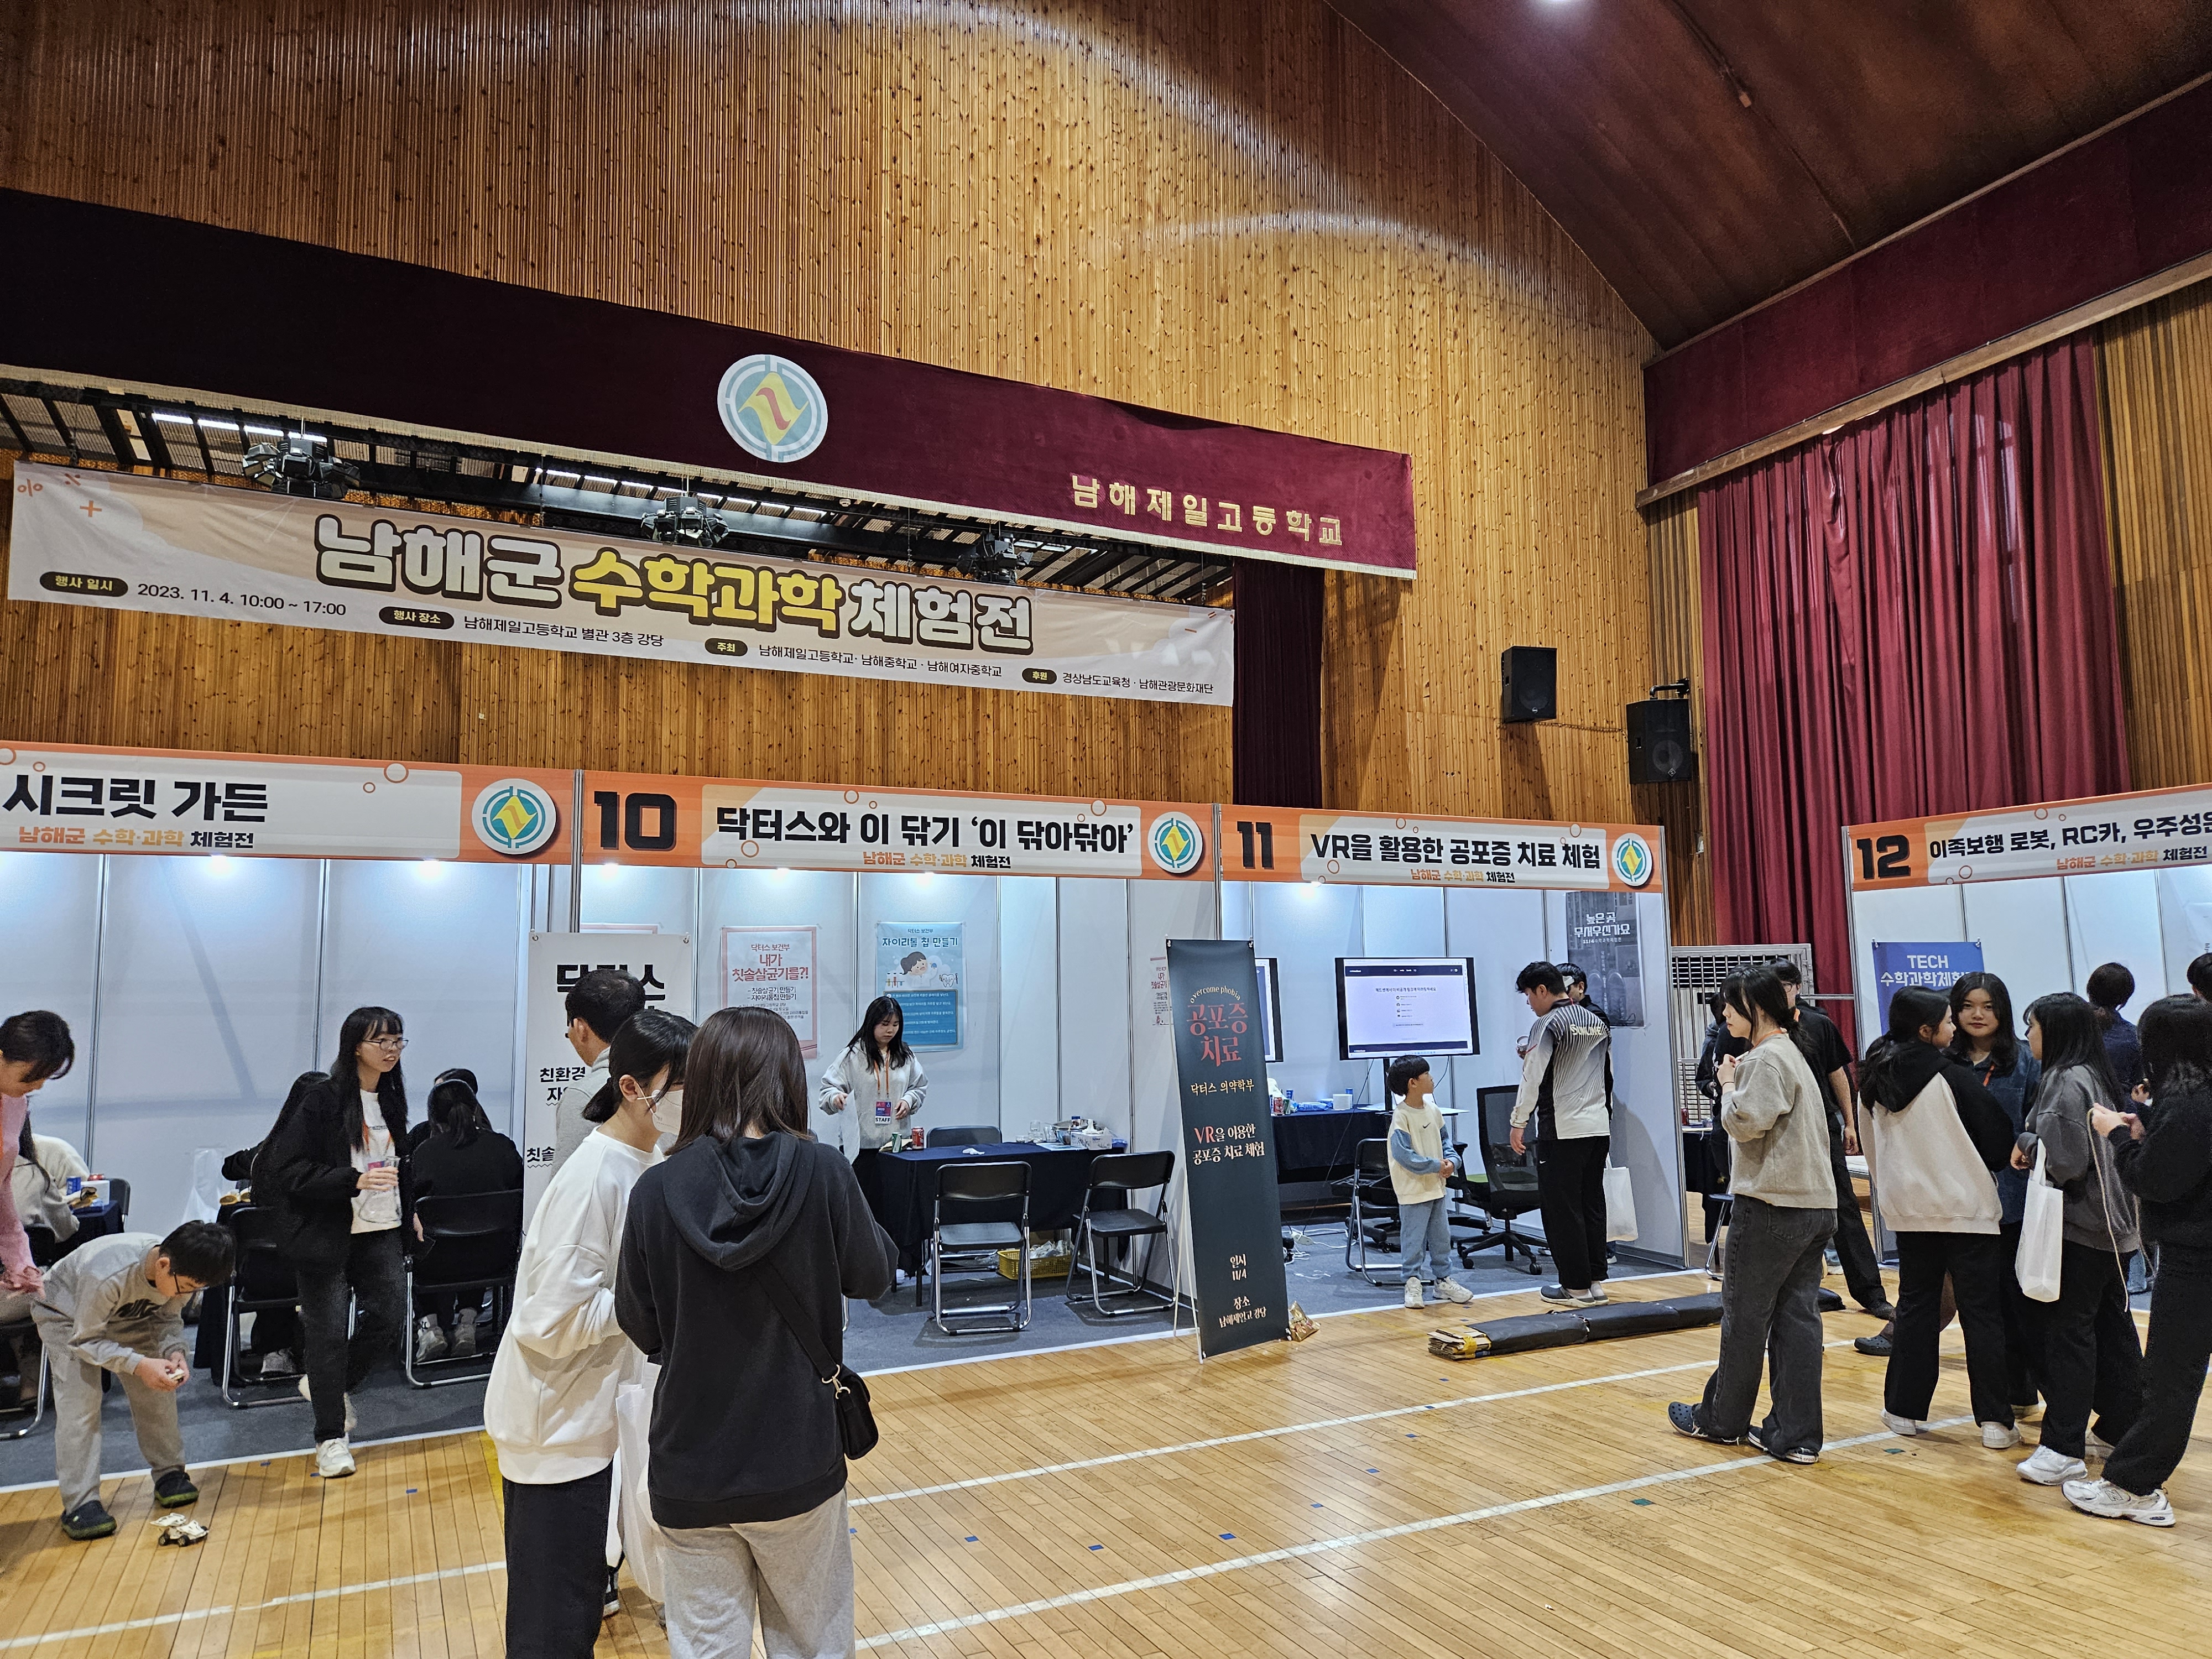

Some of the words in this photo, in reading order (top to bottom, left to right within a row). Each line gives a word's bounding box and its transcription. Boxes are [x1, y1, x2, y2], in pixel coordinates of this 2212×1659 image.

[1072, 474, 1343, 546] 남해제일고등학교
[55, 575, 82, 589] 행사
[87, 578, 113, 592] 일시
[314, 514, 564, 609] 남해군
[569, 547, 846, 639] 수학과학
[848, 578, 1033, 655] 체험전
[138, 583, 184, 600] 2023.
[240, 594, 285, 610] 10:00
[304, 601, 346, 616] 17:00
[393, 609, 416, 622] 행사
[419, 611, 441, 624] 장소
[465, 616, 577, 639] 남해제일고등학교
[581, 628, 609, 642] 별관
[612, 630, 634, 644] 3층
[638, 633, 664, 647] 강당
[717, 641, 736, 653] 주최
[861, 654, 917, 670] 남해중학교
[927, 660, 1002, 678] 남해여자중학교
[1032, 670, 1047, 681] 후원
[1062, 672, 1131, 689] 경상남도교육청
[1139, 678, 1214, 695] 남해관광문화재단
[2, 774, 157, 820] 시크릿
[171, 781, 268, 823] 가든
[594, 791, 676, 851] 10
[716, 807, 849, 844] 닥터스와
[860, 813, 889, 846] 이
[901, 815, 959, 848] 닦기
[18, 826, 85, 844] 남해군
[92, 828, 185, 847] 수학·과학
[190, 831, 254, 849] 체험전
[1237, 821, 1274, 869] 11
[1929, 834, 2005, 859] 이족보행
[2010, 828, 2057, 852] 로봇,
[2063, 822, 2127, 847] RC카,
[862, 851, 906, 866] 남해군
[909, 853, 967, 868] 수학·과학
[971, 855, 1011, 870] 체험전
[1310, 833, 1373, 862] VR을
[1379, 836, 1444, 864] 활용한
[1450, 839, 1512, 867] 공포증
[1517, 842, 1557, 868] 치료
[1562, 844, 1600, 870] 체험
[1856, 834, 1912, 880] 12
[2056, 854, 2096, 871] 남해군
[2100, 849, 2159, 867] 수학·과학
[2163, 846, 2208, 861] 체험전
[1410, 868, 1441, 881] 남해군
[1486, 872, 1516, 884] 체험전
[751, 943, 770, 952] 닥터스
[882, 937, 917, 947] 자이리톨
[921, 937, 929, 947] 칩
[932, 937, 958, 947] 만들기
[759, 953, 782, 967] 내가
[1907, 955, 1949, 969] TECH
[732, 967, 808, 982] 칫솔살균기를?!
[1190, 986, 1219, 1003] overcome
[1220, 985, 1241, 1000] phobia
[1186, 1002, 1249, 1036] 공포증
[1200, 1035, 1242, 1067] 치료
[540, 1066, 586, 1083] 친환경
[1191, 1082, 1217, 1097] 닥터스
[1220, 1078, 1255, 1094] 의약학부
[1194, 1125, 1225, 1144] VR을
[1227, 1123, 1256, 1140] 이용한
[1192, 1147, 1222, 1165] 공포증
[1224, 1145, 1244, 1160] 치료
[1245, 1141, 1265, 1157] 체험
[1230, 1254, 1246, 1269] 일시
[1232, 1269, 1247, 1281] 11/4
[1233, 1296, 1251, 1310] 장소
[1253, 1306, 1267, 1319] 강당
